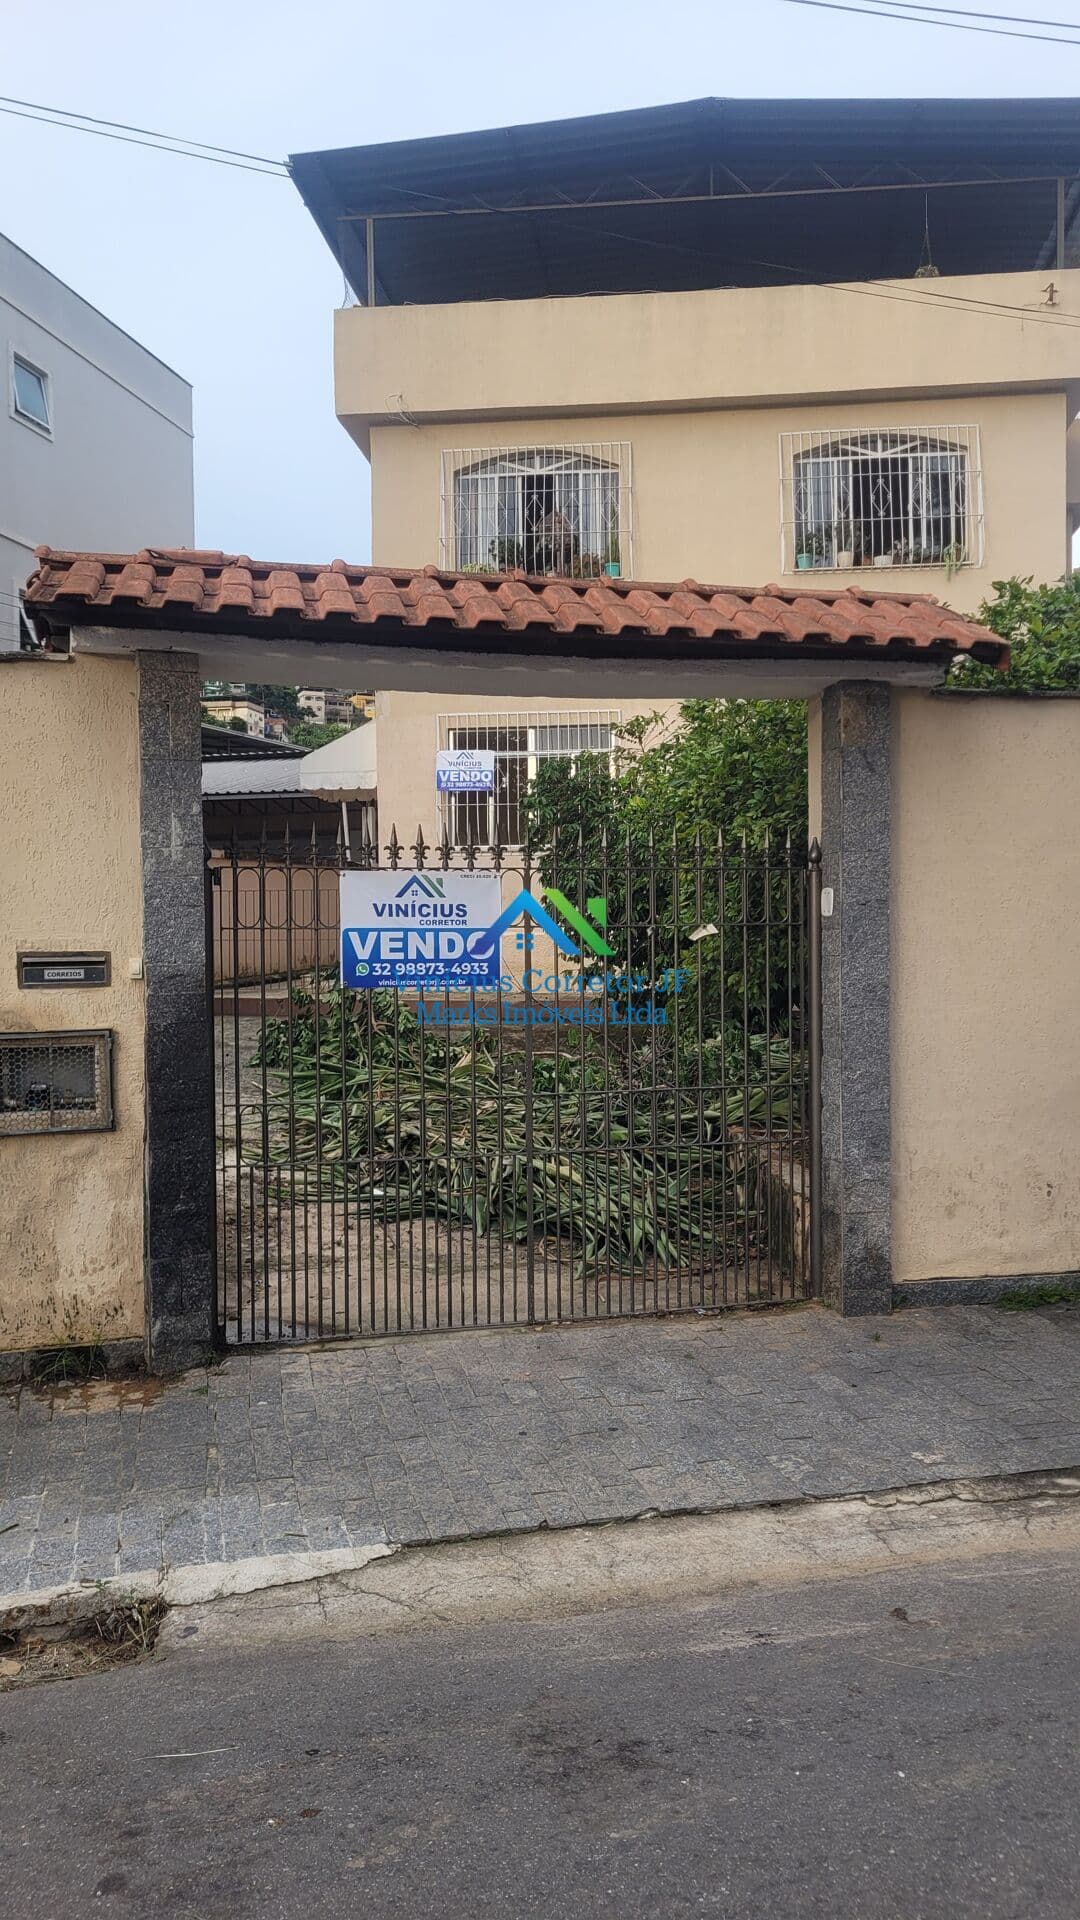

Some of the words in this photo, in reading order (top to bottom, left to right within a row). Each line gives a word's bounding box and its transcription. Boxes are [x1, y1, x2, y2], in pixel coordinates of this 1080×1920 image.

[438, 771, 492, 782] VENDO
[372, 900, 468, 918] VINÍCIUS
[348, 931, 495, 960] VENDO
[372, 963, 391, 976] 32
[395, 963, 489, 976] 98873-4933
